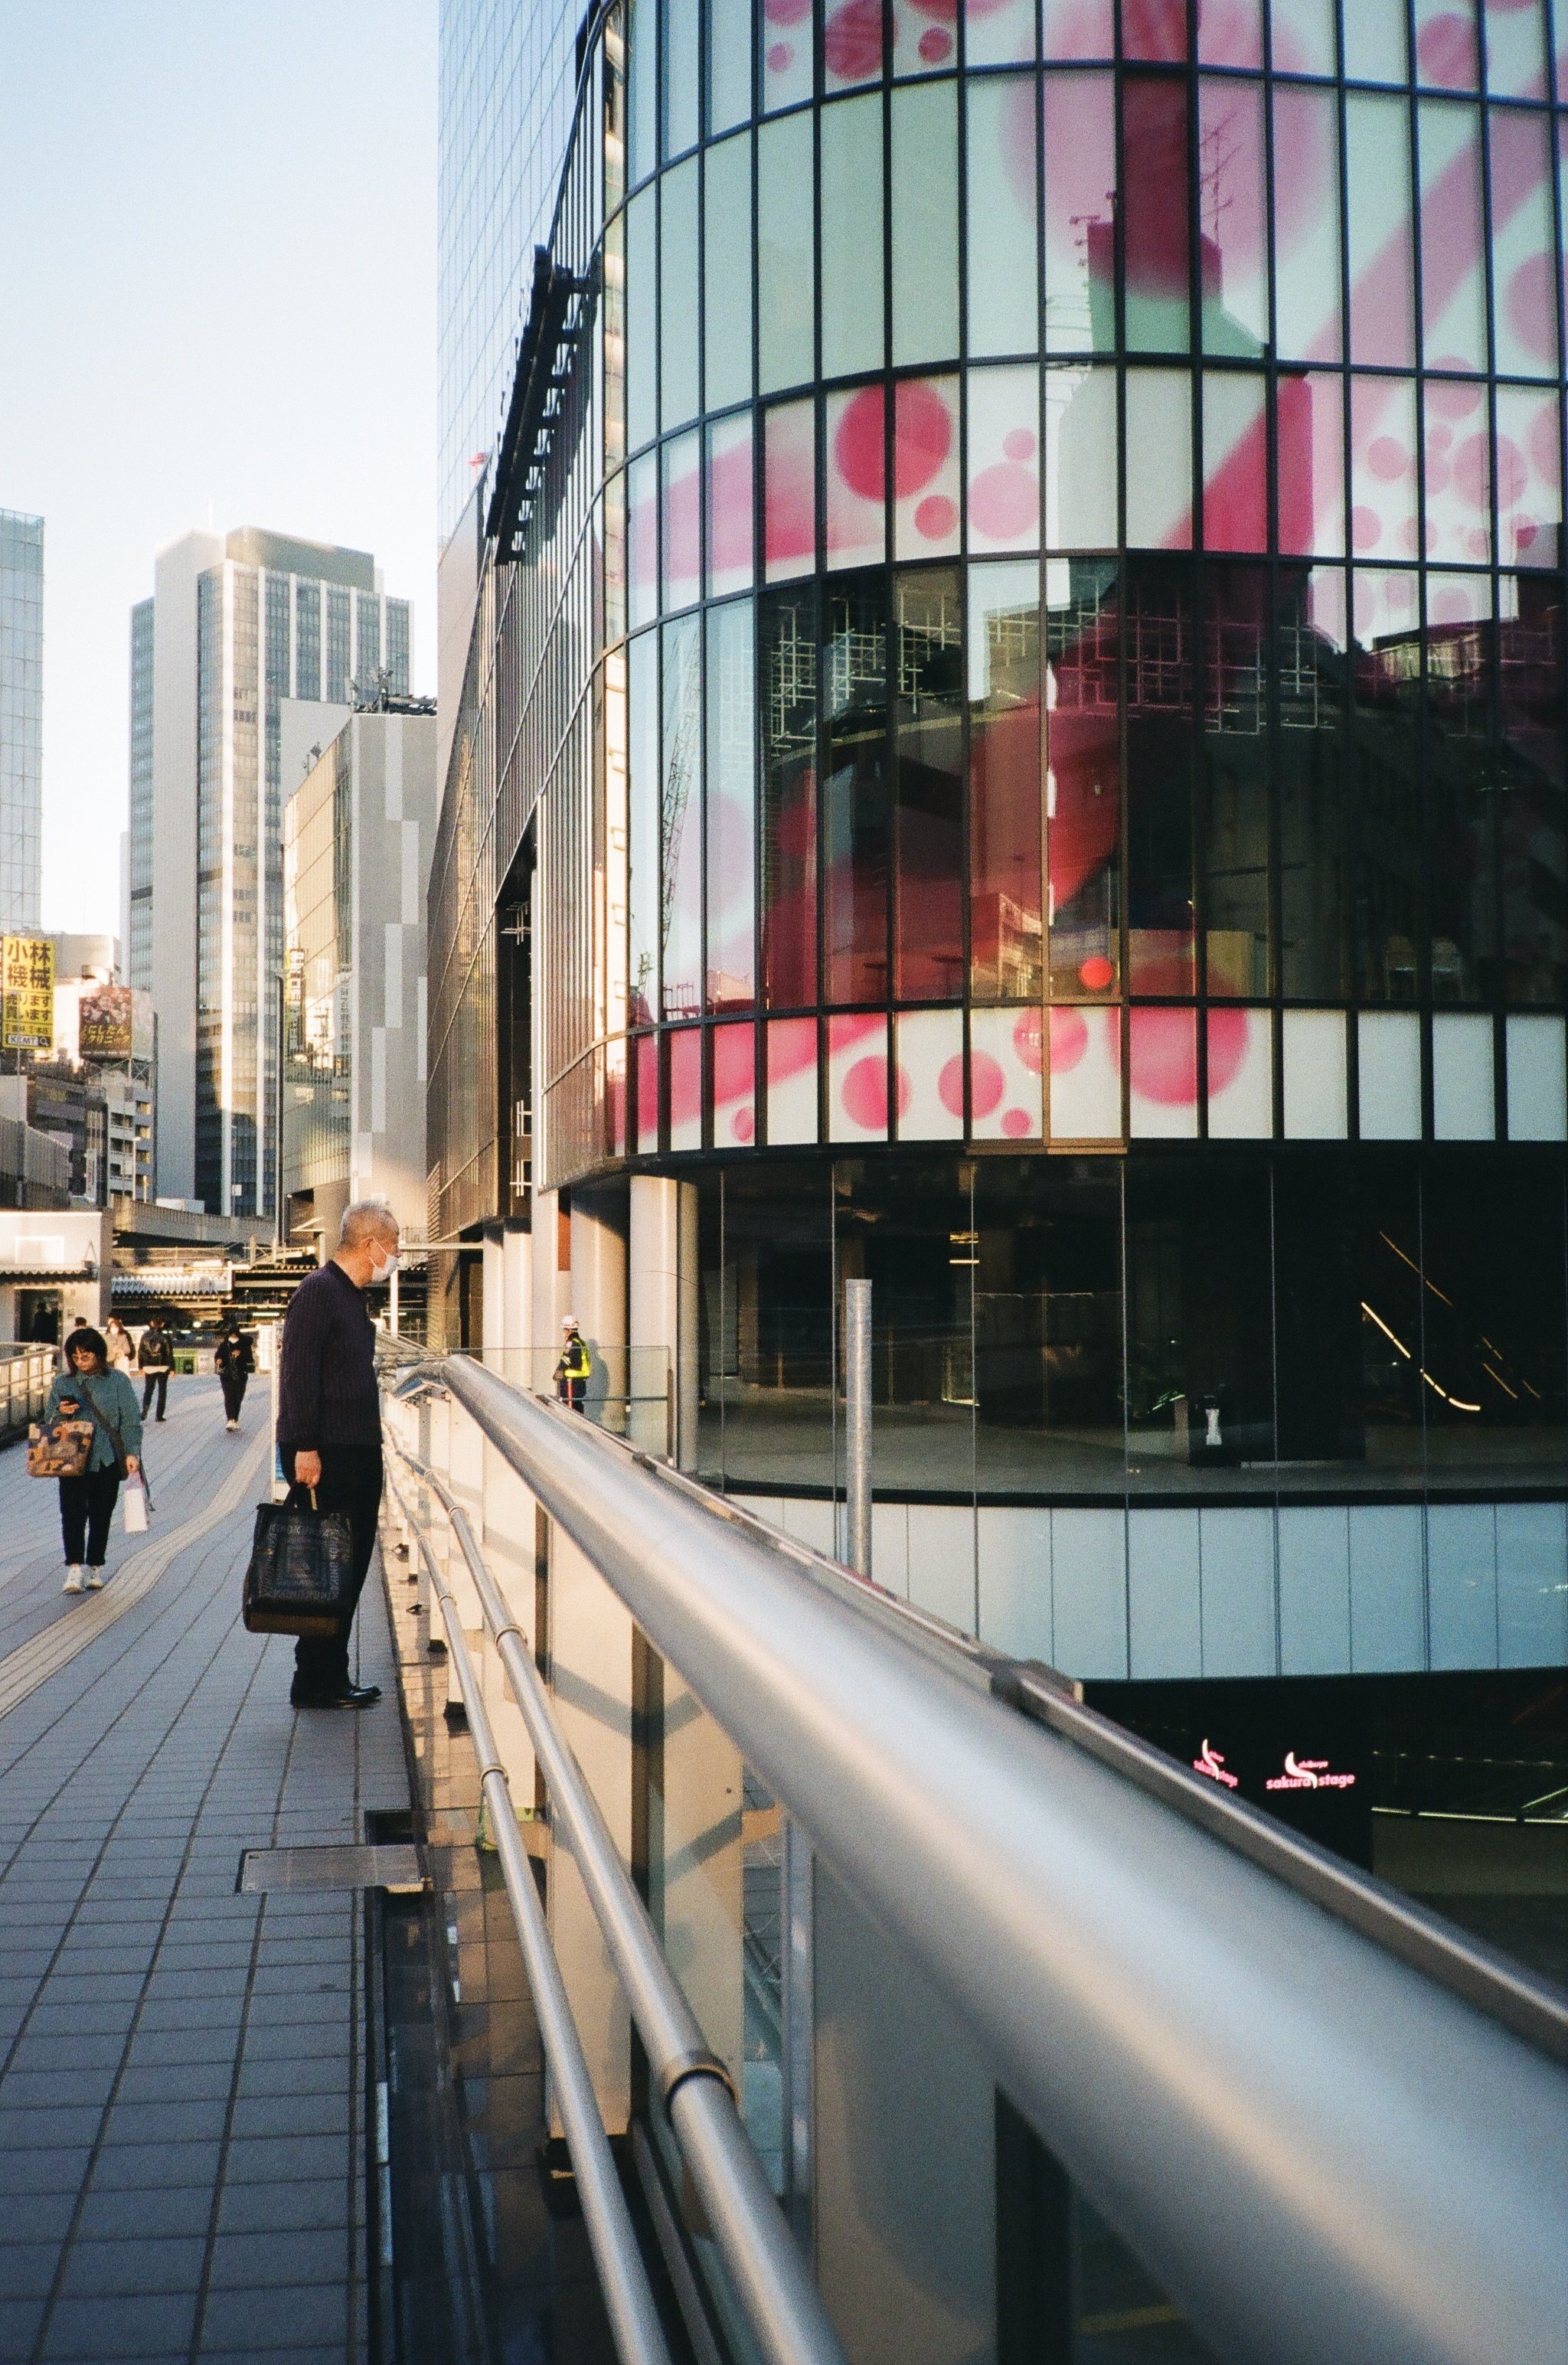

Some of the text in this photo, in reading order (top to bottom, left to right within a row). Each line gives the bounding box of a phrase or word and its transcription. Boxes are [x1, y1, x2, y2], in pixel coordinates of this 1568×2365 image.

[8, 940, 51, 965] 小林
[7, 964, 51, 990] 機械
[1266, 1774, 1355, 1789] sakura stage
